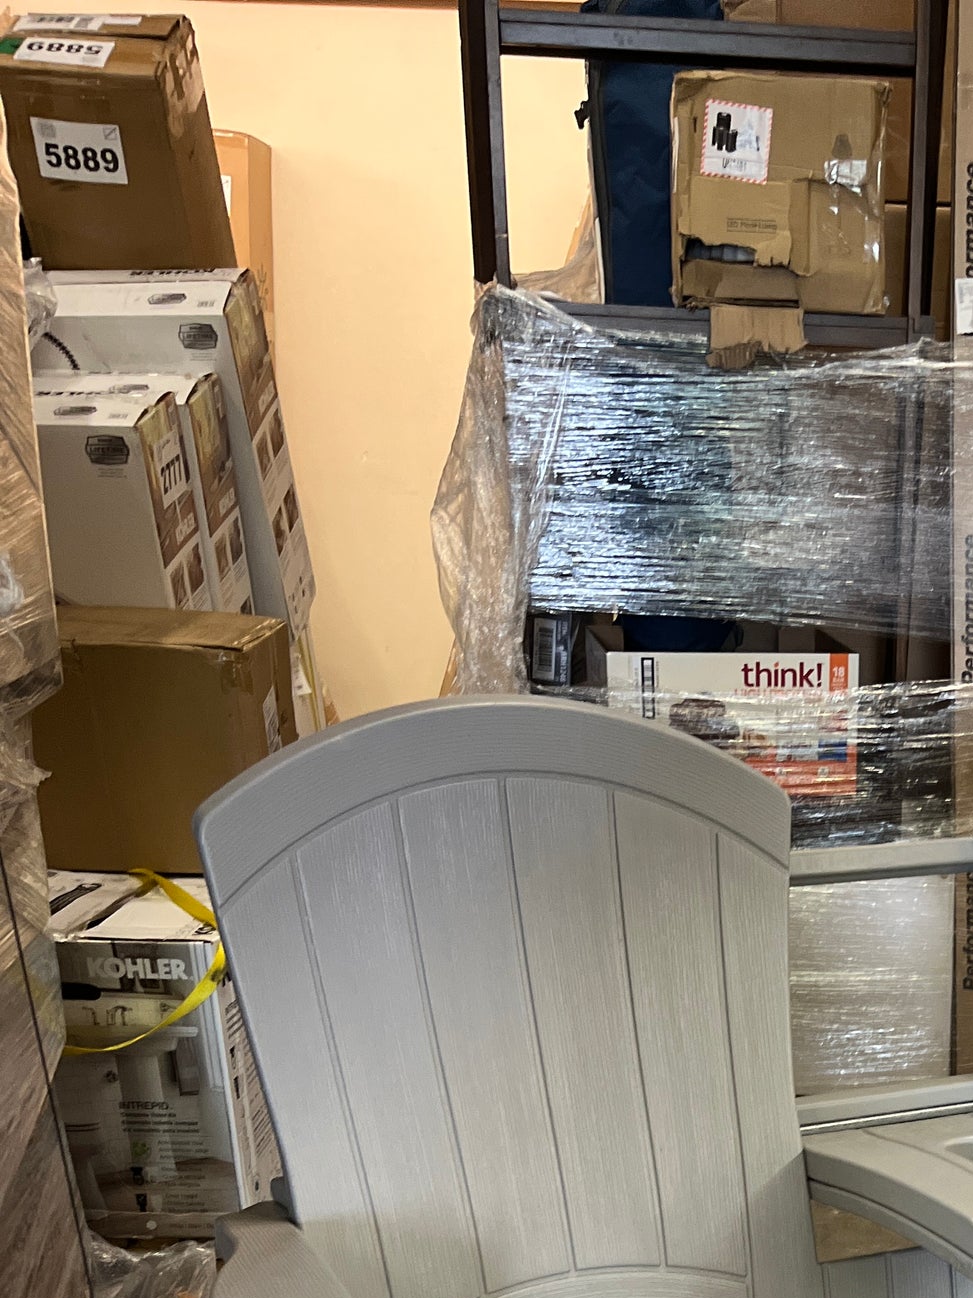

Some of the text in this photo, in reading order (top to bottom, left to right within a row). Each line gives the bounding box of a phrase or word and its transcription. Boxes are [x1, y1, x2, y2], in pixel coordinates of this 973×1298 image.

[44, 142, 120, 174] 5889
[740, 660, 823, 688] think!
[832, 666, 845, 679] 18
[86, 956, 189, 980] KOHLER
